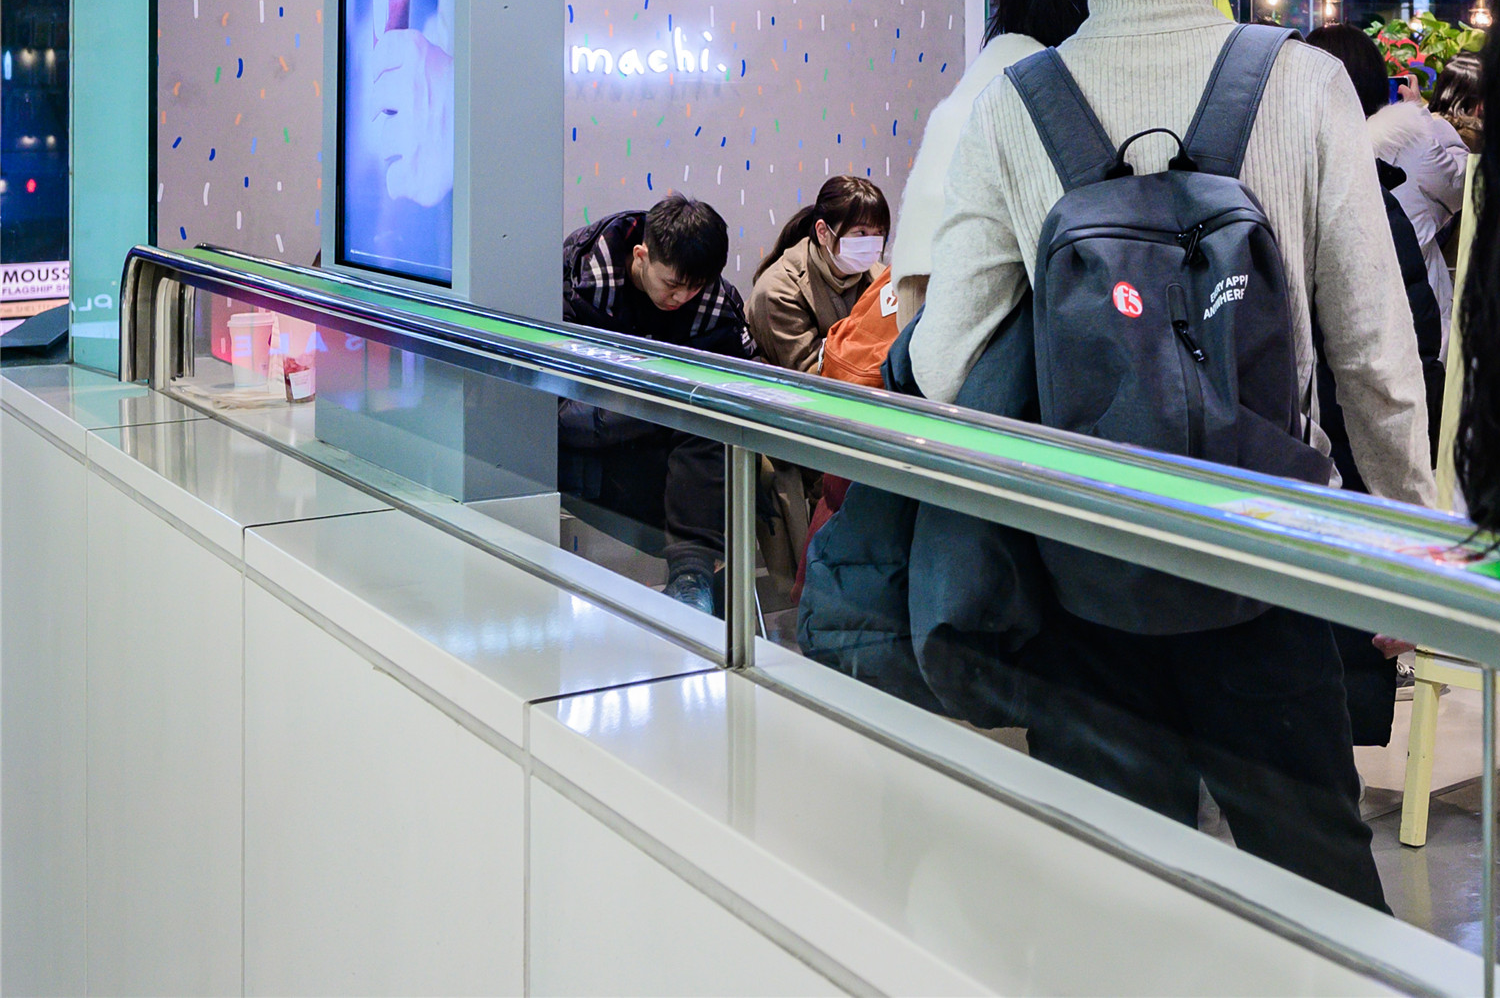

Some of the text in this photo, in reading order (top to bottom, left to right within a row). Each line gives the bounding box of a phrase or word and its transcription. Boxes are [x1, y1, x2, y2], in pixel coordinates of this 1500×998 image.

[570, 26, 727, 75] machi.
[3, 267, 69, 283] MOUSS
[1113, 285, 1143, 315] f5
